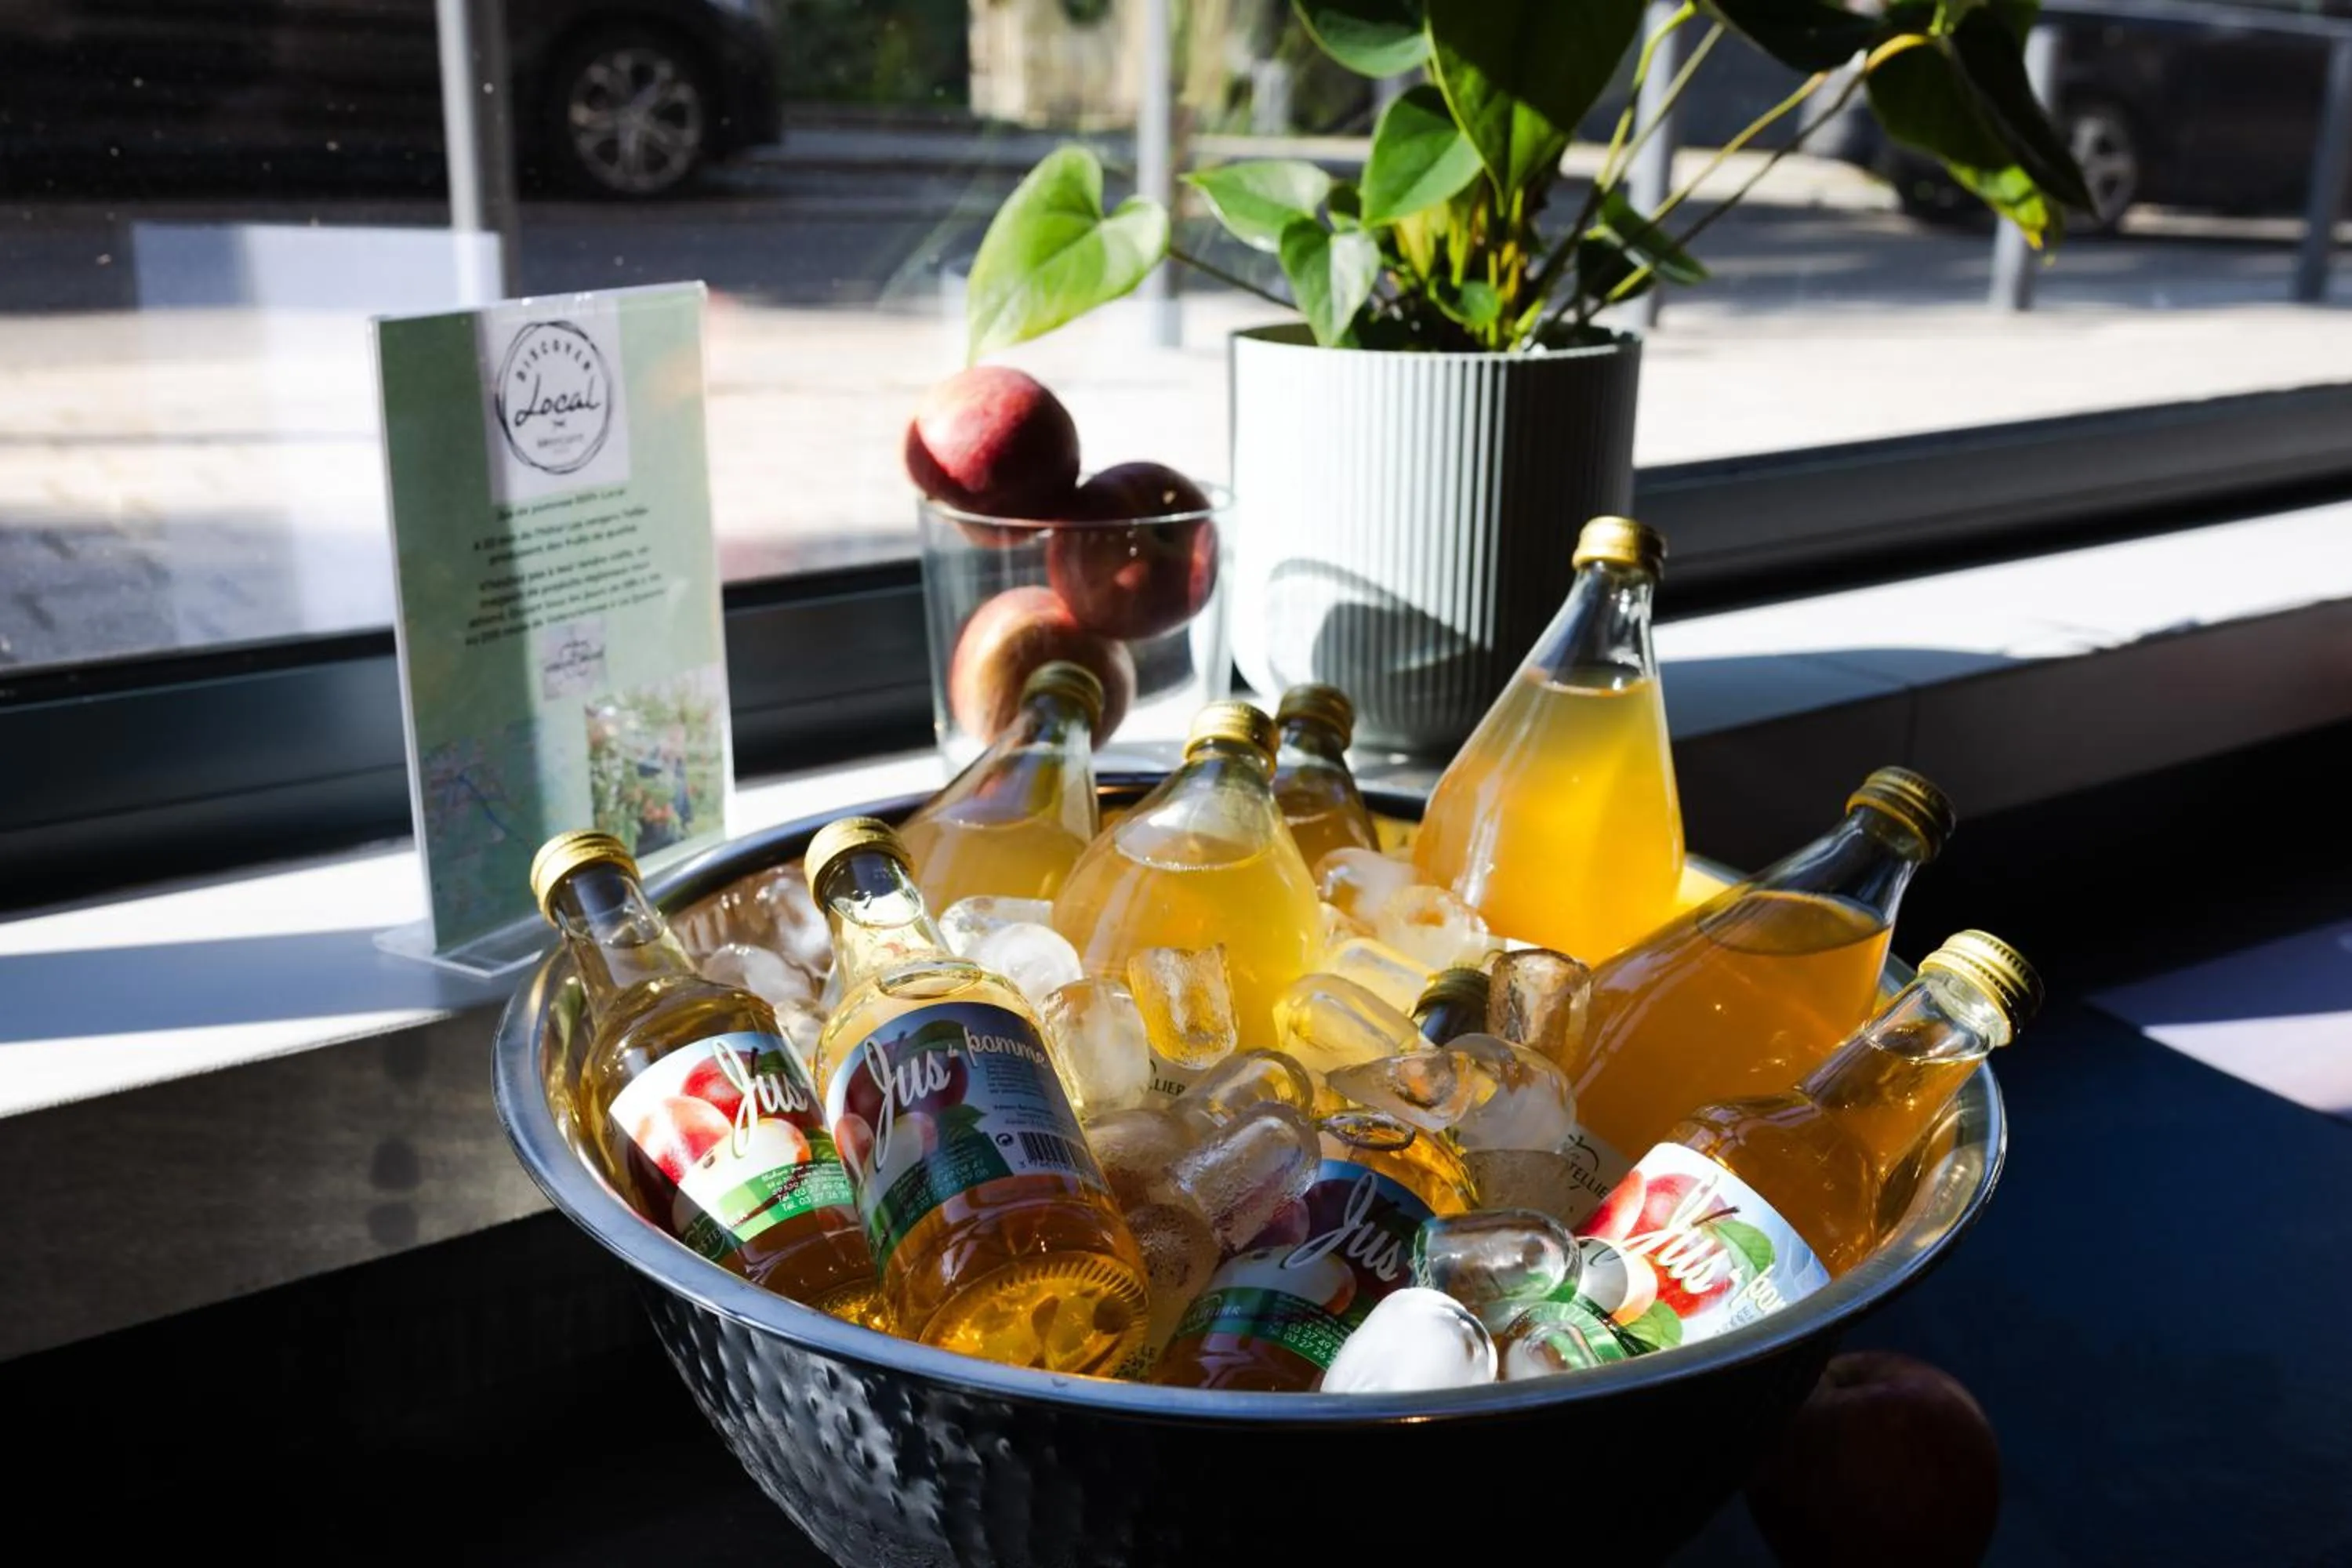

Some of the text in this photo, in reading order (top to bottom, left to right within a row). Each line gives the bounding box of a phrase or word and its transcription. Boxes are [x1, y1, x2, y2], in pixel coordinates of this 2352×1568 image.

[514, 373, 601, 427] Local
[515, 339, 592, 382] DISCOVER
[712, 1039, 808, 1159] Jus
[864, 1036, 951, 1172] Jus
[1281, 1172, 1400, 1283] Jus
[1589, 1174, 1728, 1294] Jus
[1298, 1338, 1315, 1350] 27
